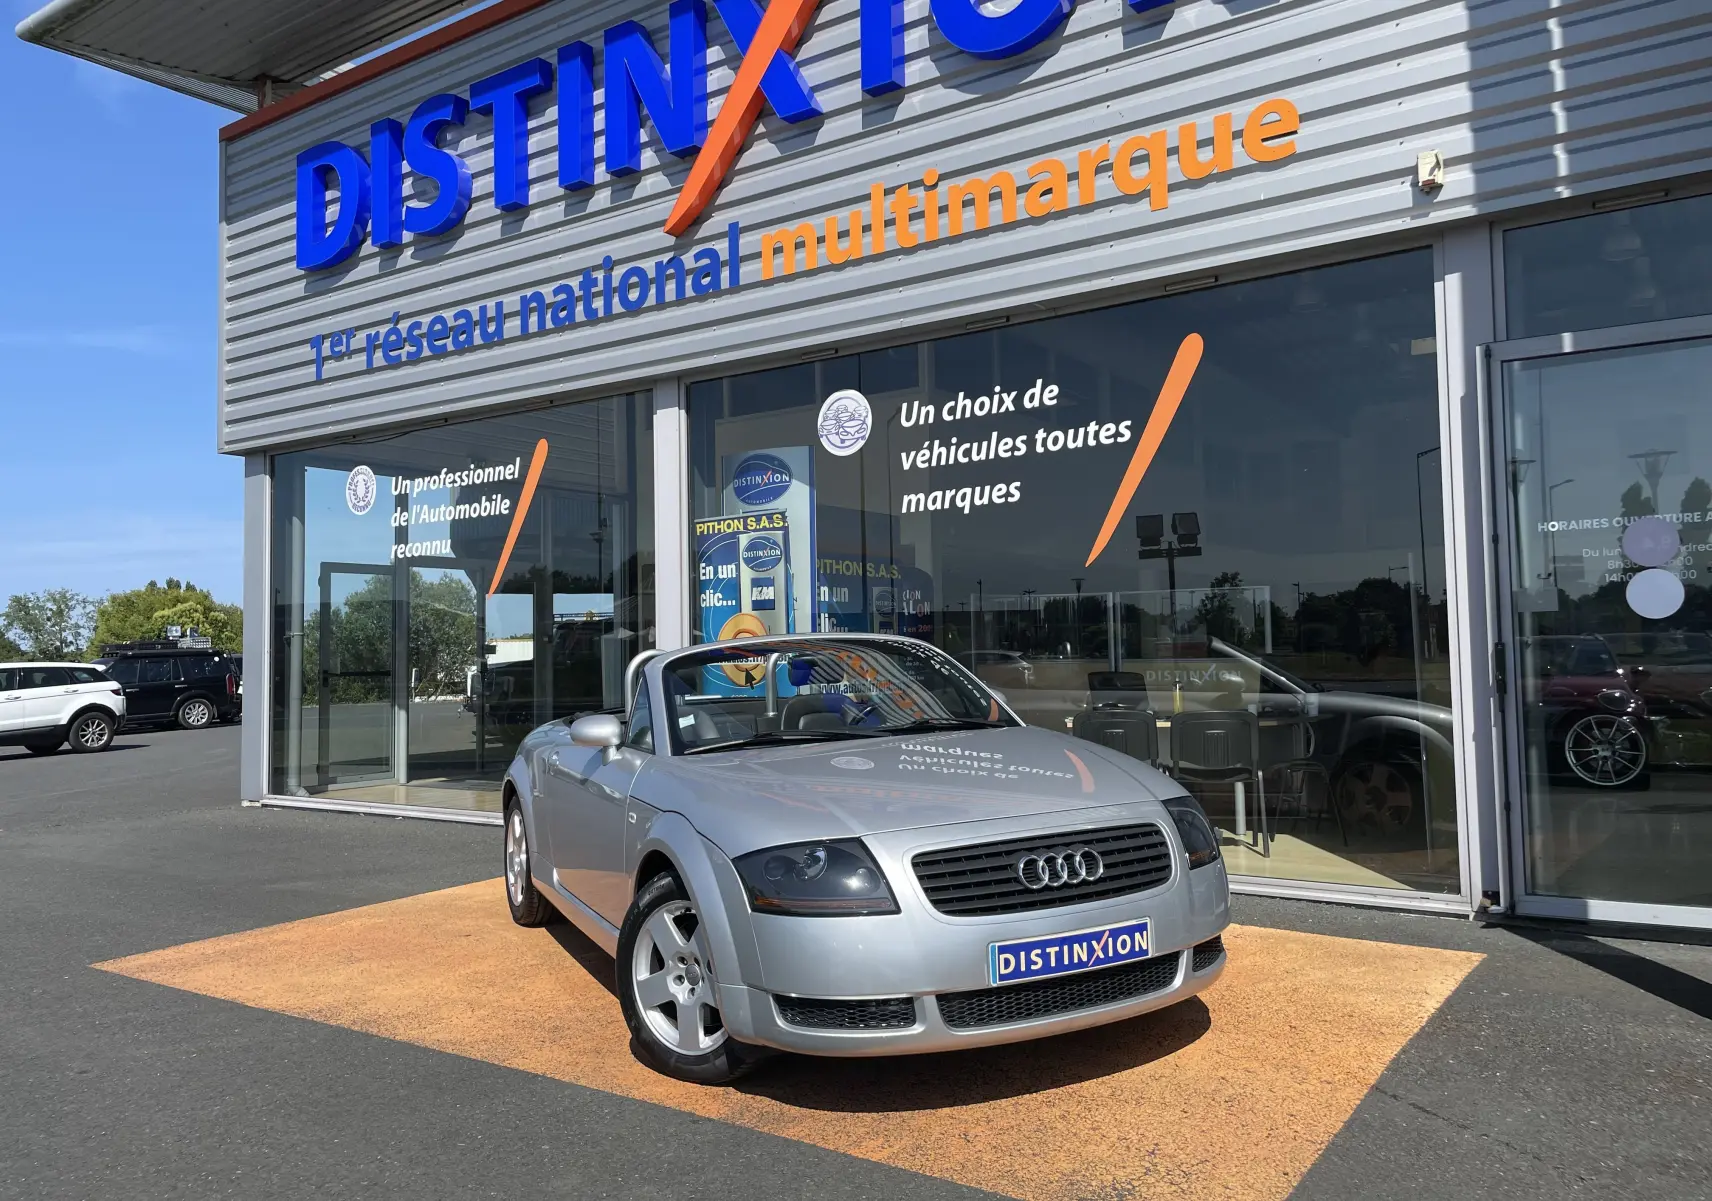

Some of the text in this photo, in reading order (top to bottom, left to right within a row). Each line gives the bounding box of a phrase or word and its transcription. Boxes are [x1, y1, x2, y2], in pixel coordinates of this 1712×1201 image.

[310, 98, 1300, 380] 1er réseau national multimarque
[900, 378, 1059, 428] Un choix de
[900, 420, 1132, 471] véhicules toutes
[391, 457, 520, 497] Un professionnel
[734, 470, 790, 488] DISTINXION
[901, 481, 1021, 514] marques
[391, 494, 510, 527] de l'Automobile
[696, 514, 788, 536] PITHON S.A.S.
[1538, 518, 1609, 532] HORAIRES
[391, 539, 451, 559] reconnu
[743, 546, 781, 559] DISTINXION
[1582, 548, 1600, 557] Du
[700, 562, 736, 580] En un
[700, 589, 736, 607] clic...
[1000, 930, 1148, 975] DISTINXION
